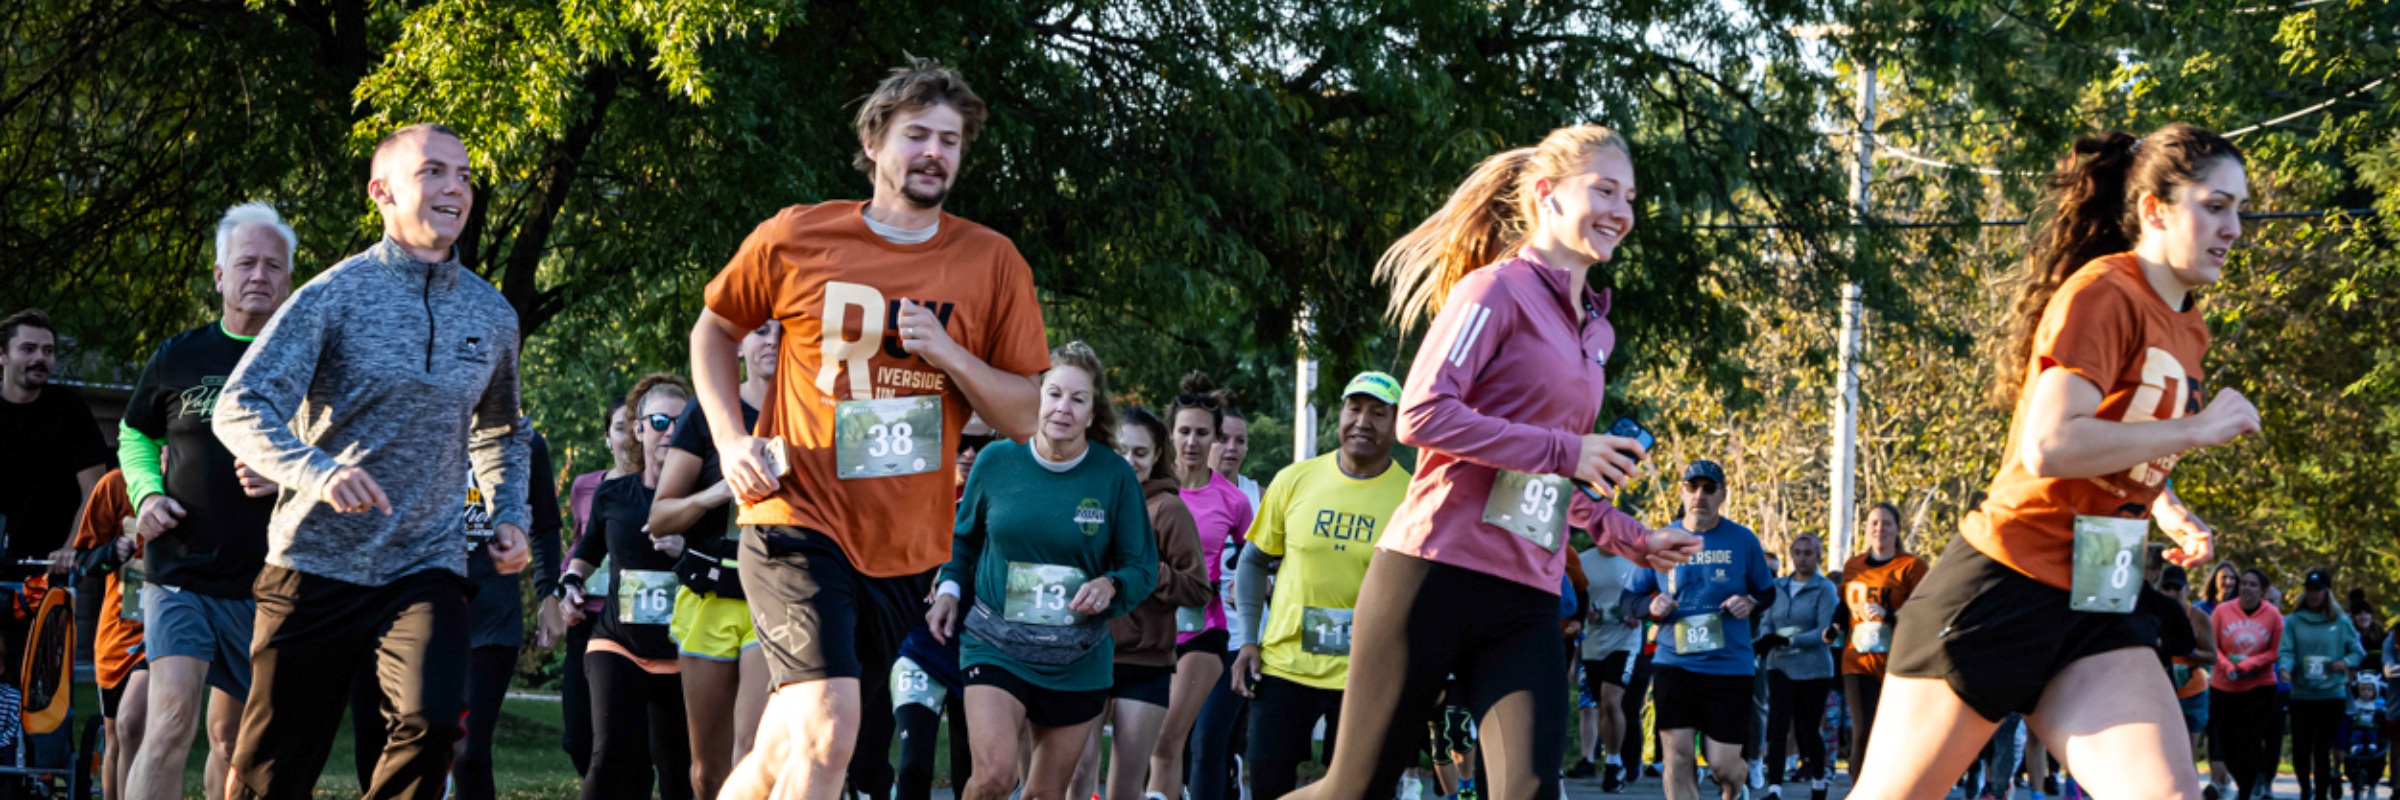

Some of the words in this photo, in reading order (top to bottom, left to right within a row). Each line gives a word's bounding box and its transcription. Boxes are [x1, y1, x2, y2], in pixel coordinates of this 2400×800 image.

[868, 422, 913, 458] 38
[1520, 478, 1558, 523] 93
[1313, 509, 1376, 543] RUN
[2111, 549, 2133, 590] 8
[637, 588, 667, 611] 16
[1031, 583, 1066, 611] 13
[1687, 626, 1709, 643] 82
[898, 671, 928, 691] 63
